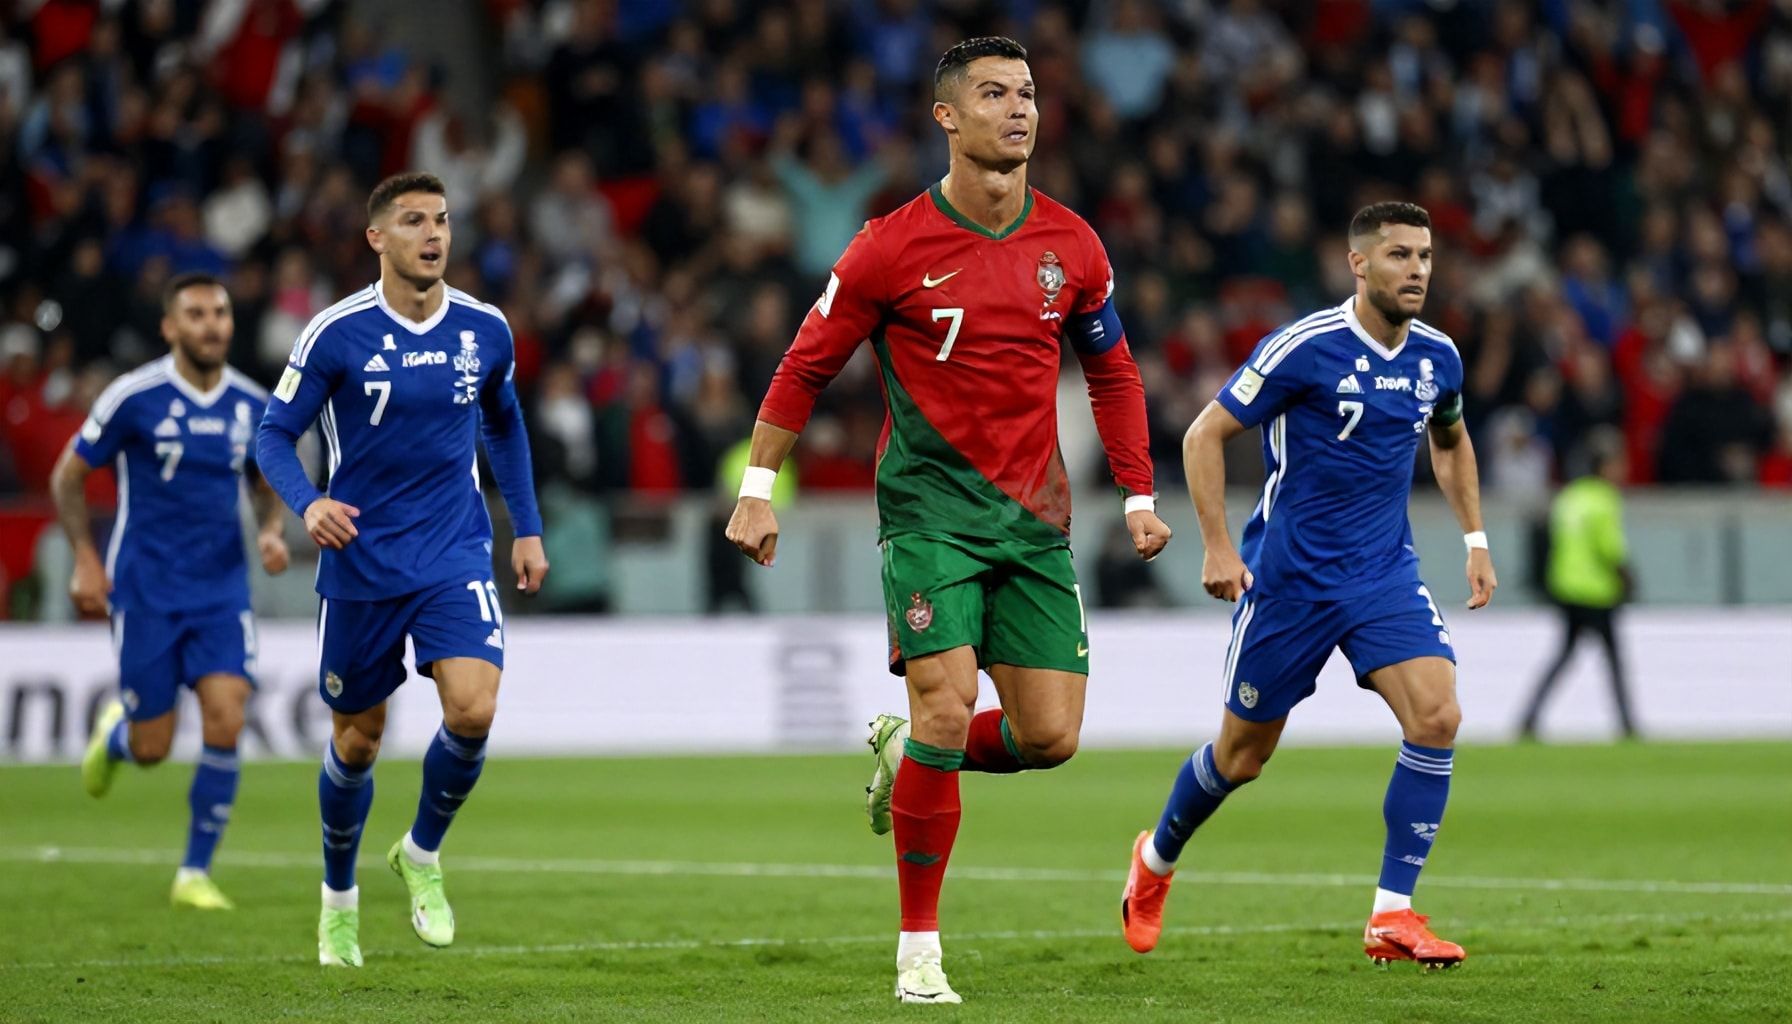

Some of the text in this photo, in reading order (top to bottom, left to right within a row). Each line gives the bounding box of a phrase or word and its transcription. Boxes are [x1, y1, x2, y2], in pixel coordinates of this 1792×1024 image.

[931, 307, 965, 361] 7
[363, 380, 391, 426] 7
[1337, 400, 1364, 441] 7
[154, 440, 184, 482] 7
